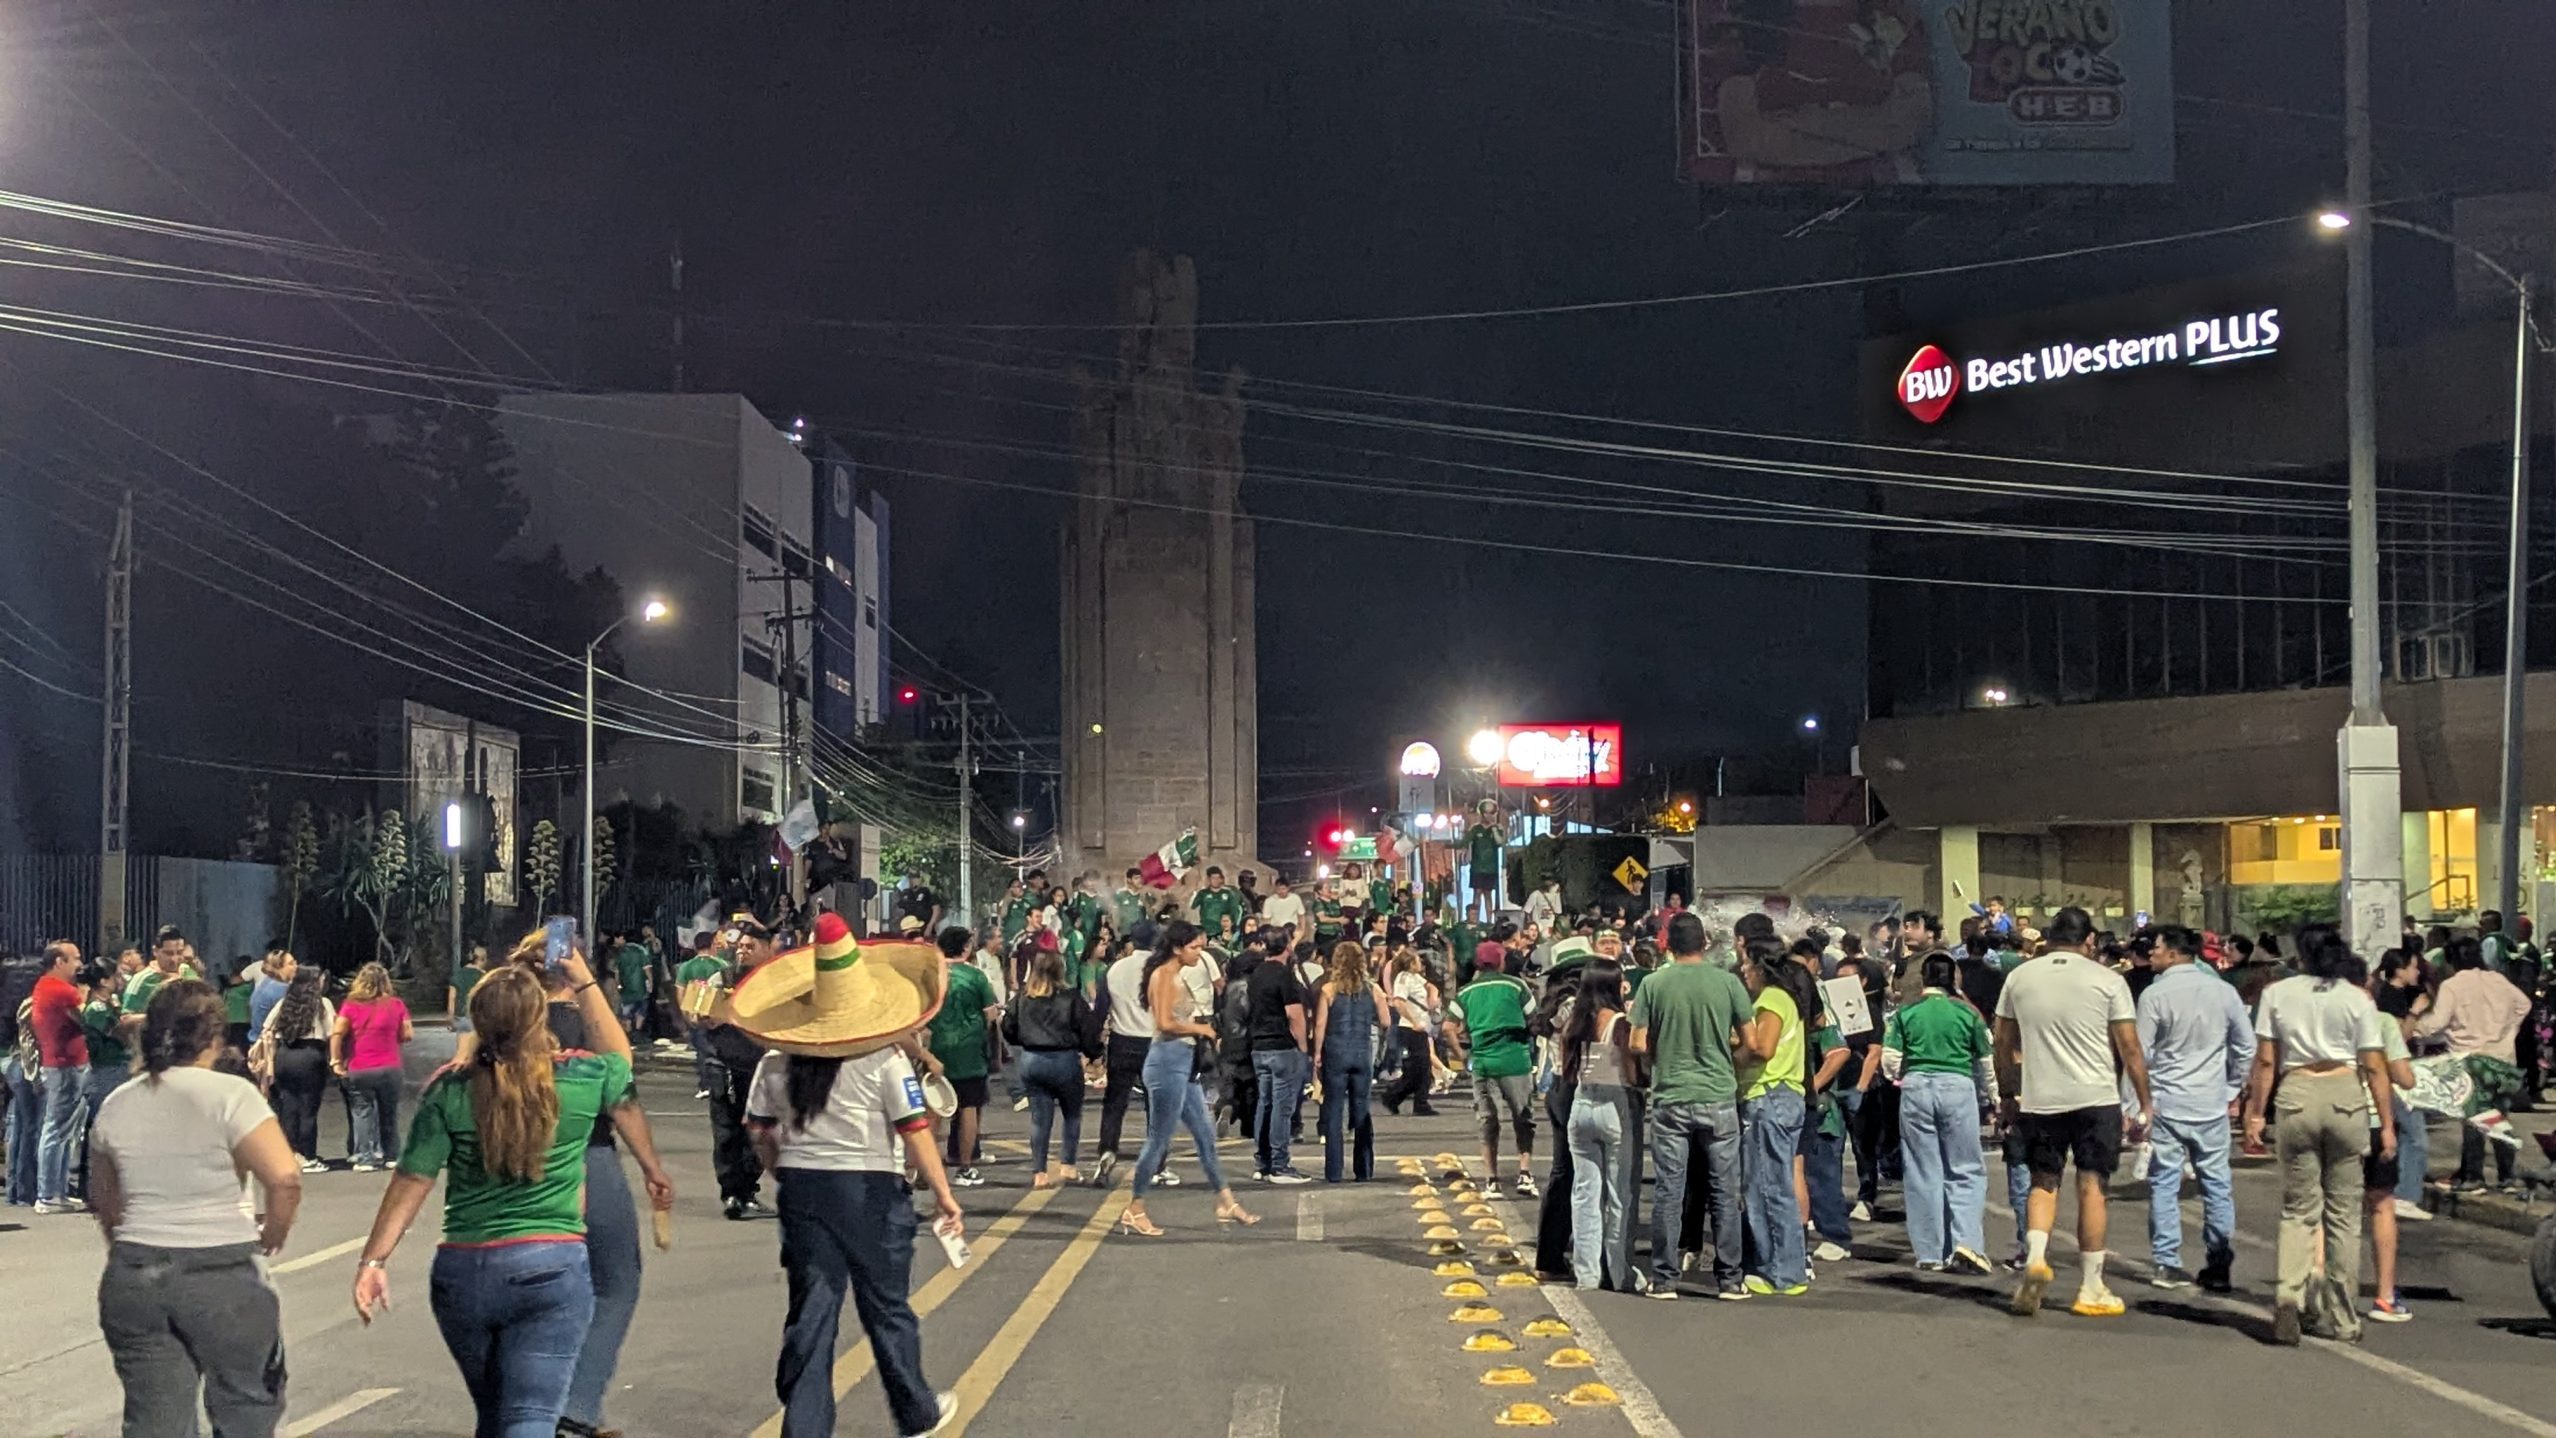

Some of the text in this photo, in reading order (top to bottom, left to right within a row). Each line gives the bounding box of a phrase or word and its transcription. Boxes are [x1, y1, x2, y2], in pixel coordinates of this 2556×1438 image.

[1968, 309, 2279, 392] Best Western PLUS
[1906, 364, 1952, 403] BW
